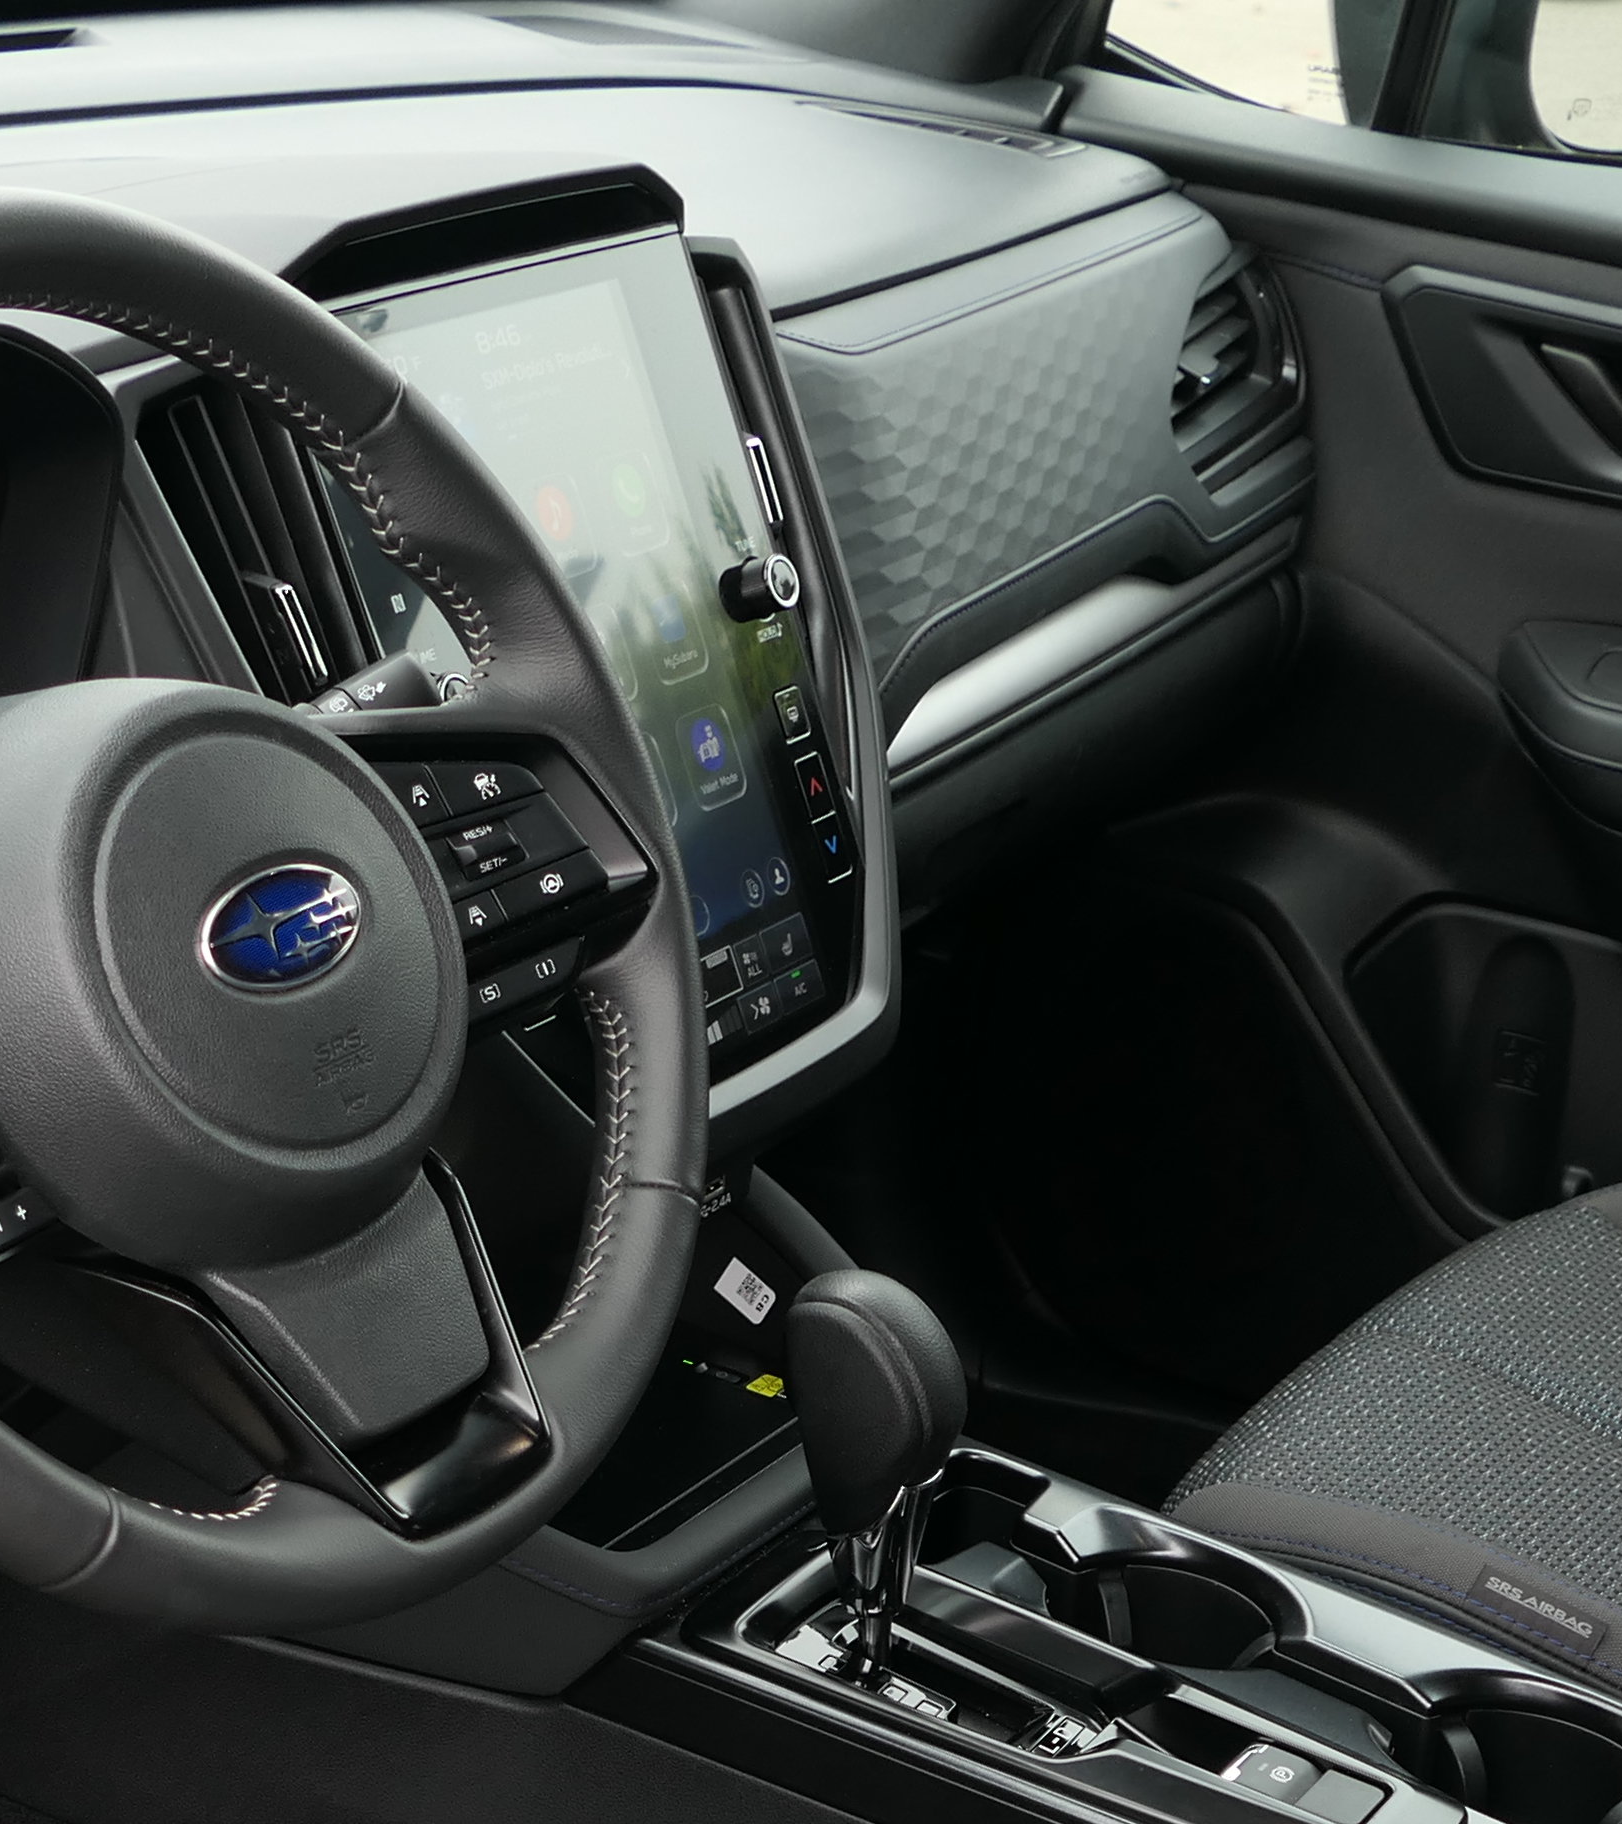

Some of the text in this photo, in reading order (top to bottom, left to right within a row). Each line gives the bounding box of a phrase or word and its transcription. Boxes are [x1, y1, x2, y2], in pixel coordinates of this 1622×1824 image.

[475, 324, 521, 354] 8:46
[719, 772, 740, 788] Mode
[1485, 1576, 1592, 1637] SRS AIRBAG
